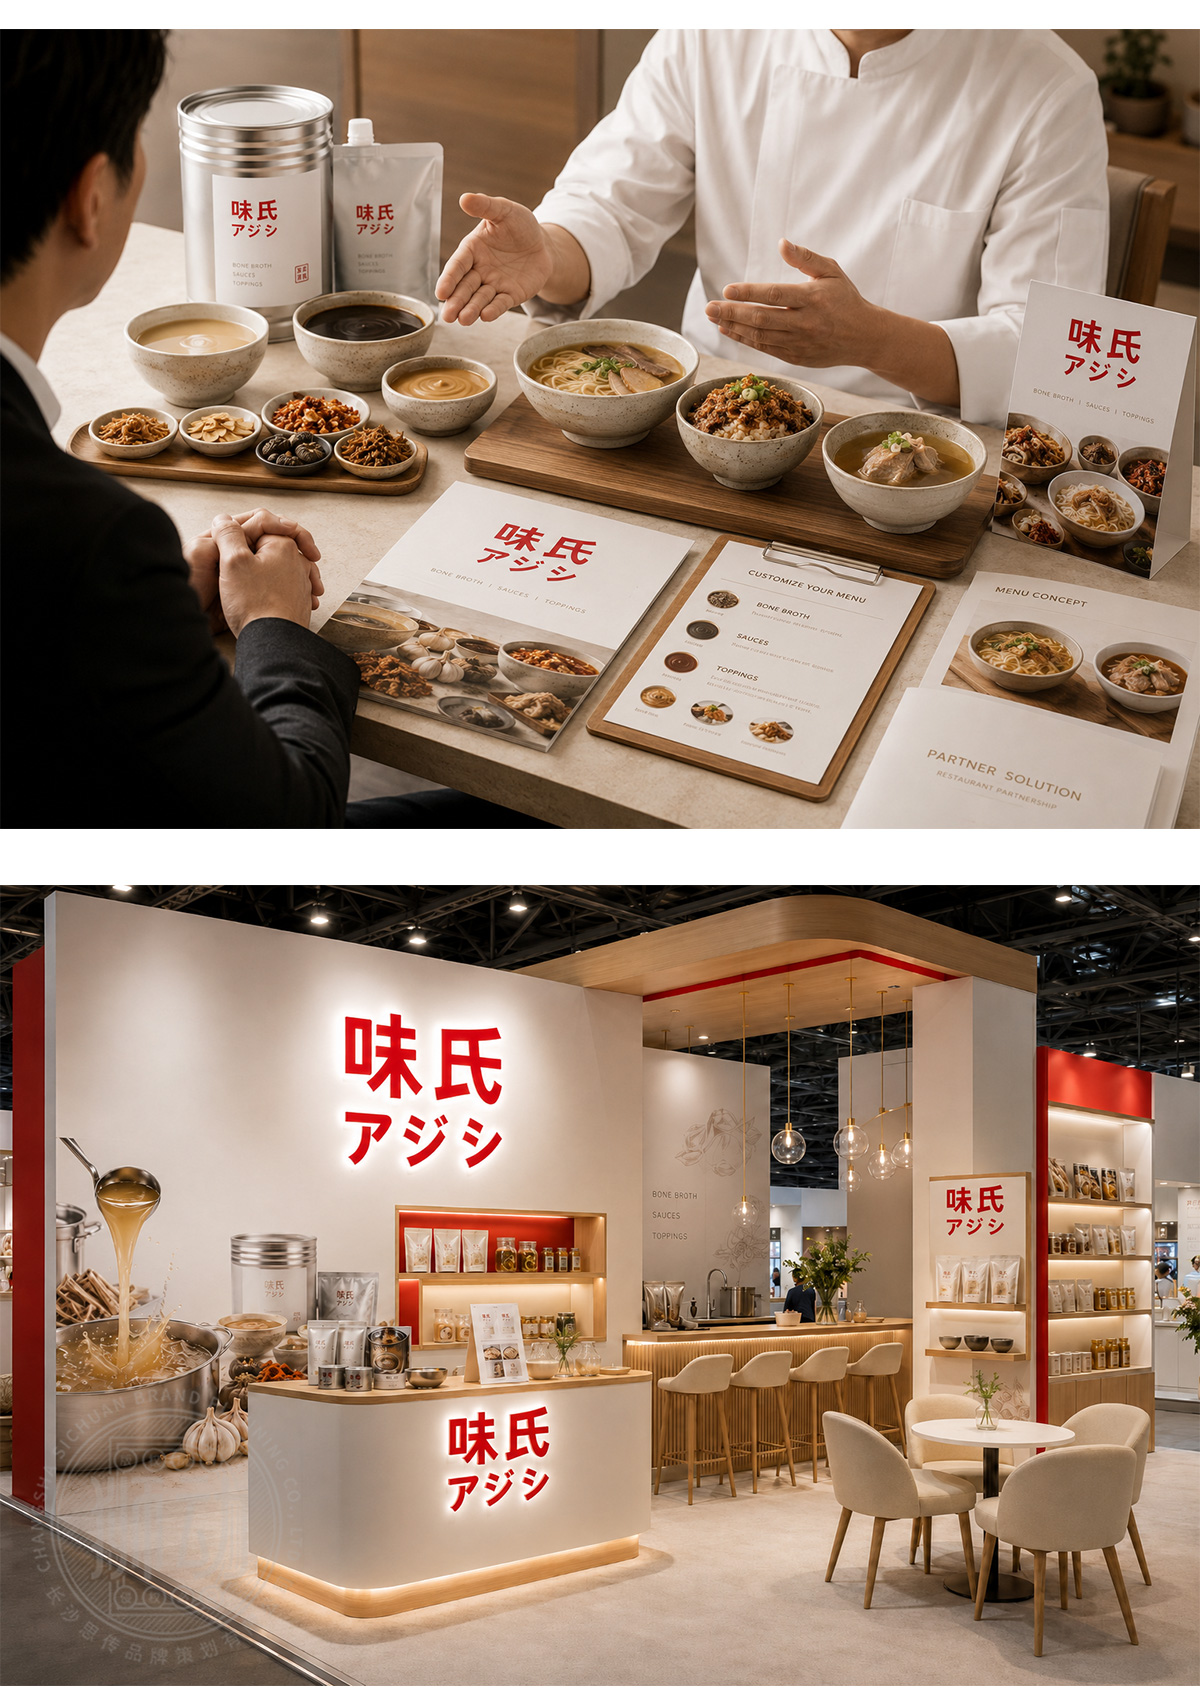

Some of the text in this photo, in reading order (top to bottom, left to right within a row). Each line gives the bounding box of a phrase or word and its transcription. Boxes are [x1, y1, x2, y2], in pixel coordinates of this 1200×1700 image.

[231, 200, 278, 221] 味氏
[356, 203, 394, 222] 味氏
[231, 223, 278, 238] アジシ
[356, 223, 394, 235] アジシ
[1068, 318, 1142, 365] 味氏
[1064, 354, 1137, 389] アジシ
[494, 522, 597, 566] 味氏
[477, 547, 577, 582] アジシ
[748, 569, 867, 604] CUSTOMIZE YOUR MENU
[994, 586, 1088, 608] MENU CONCEPT
[756, 601, 811, 620] BONE BROTH
[927, 749, 1082, 802] PARTNER SOLUTION
[936, 770, 1058, 810] RESTAURANT PARTNERSHIP
[345, 1013, 502, 1105] 味氏
[345, 1111, 502, 1168] アジシ
[652, 1190, 698, 1200] BONE BROTH
[946, 1185, 1004, 1214] 味氏
[652, 1211, 680, 1219] SAUCES
[946, 1217, 1004, 1236] アジシ
[652, 1232, 688, 1240] TOPPINGS
[449, 1406, 550, 1465] 味氏
[448, 1468, 550, 1512] アジシ
